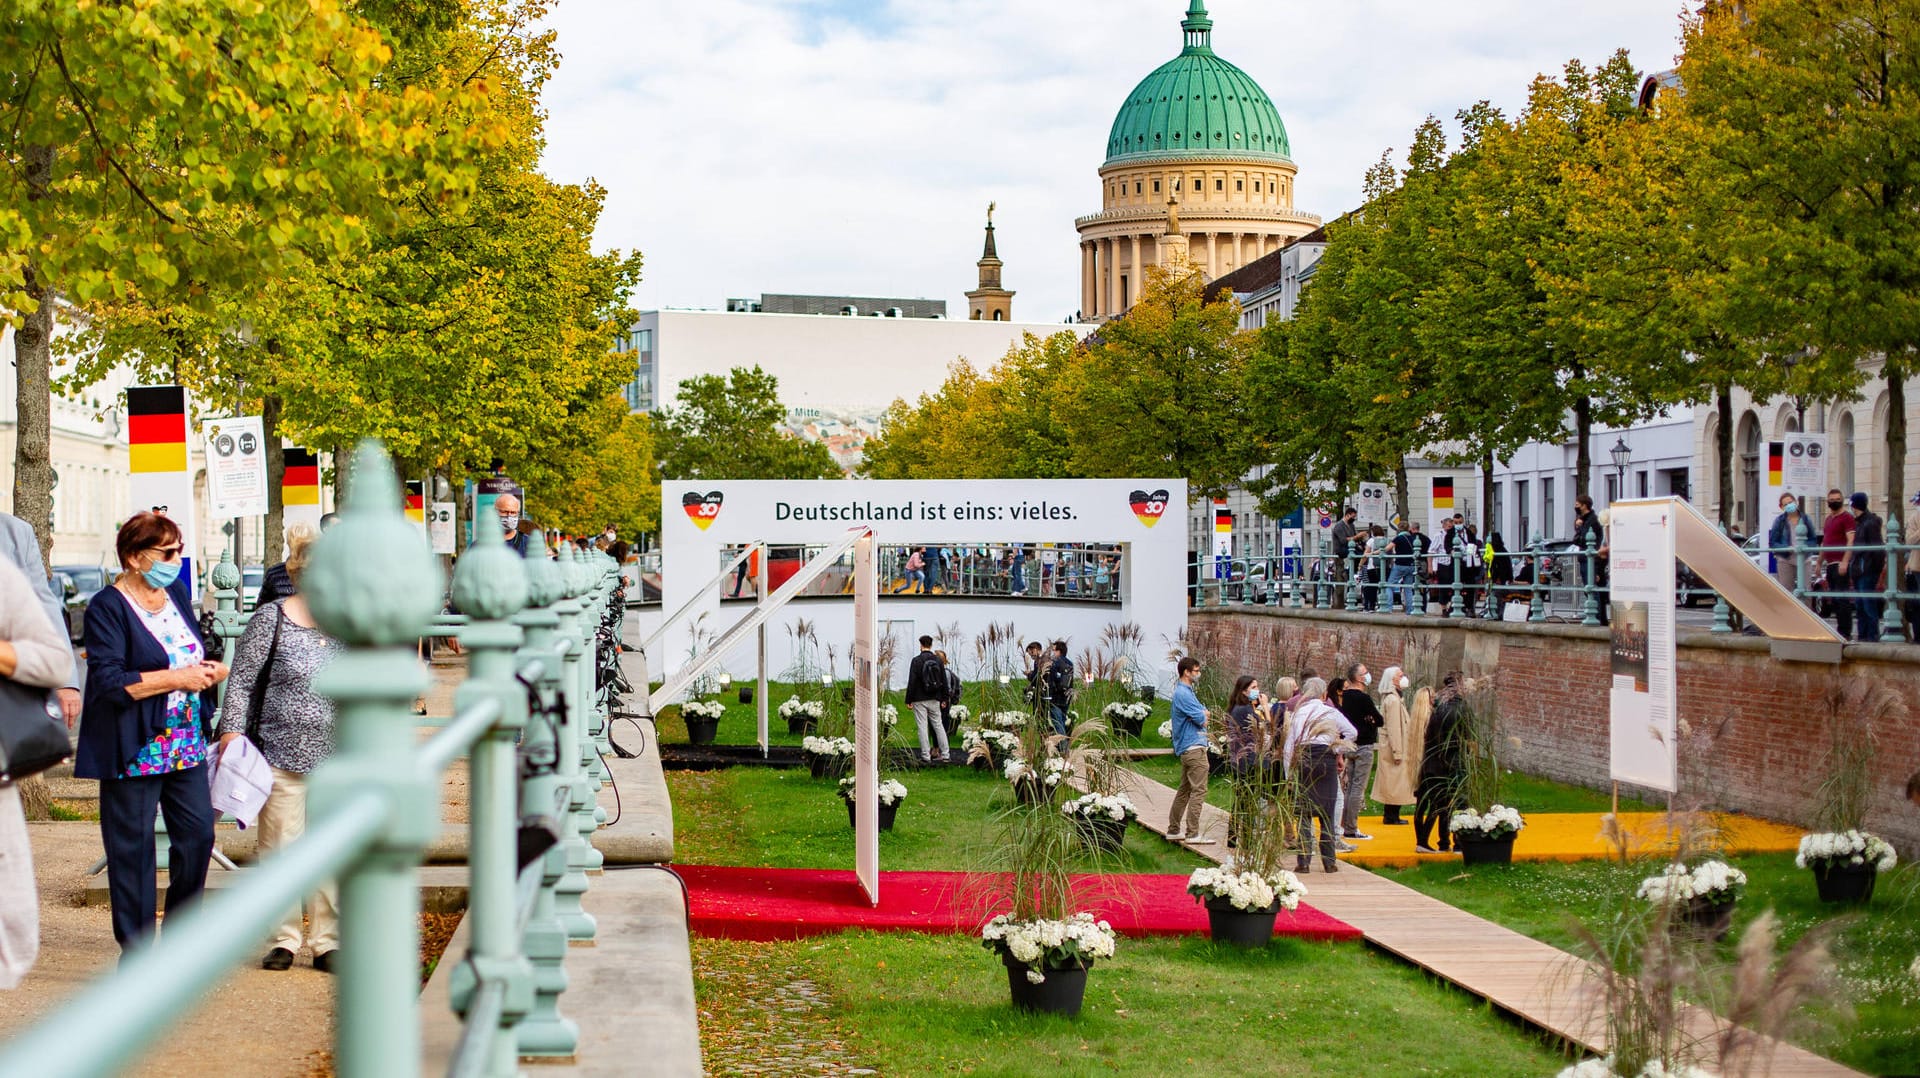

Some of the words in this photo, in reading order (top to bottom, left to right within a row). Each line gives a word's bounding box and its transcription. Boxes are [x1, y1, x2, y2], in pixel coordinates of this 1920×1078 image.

[794, 408, 821, 417] Mitte
[698, 502, 718, 516] 30
[776, 501, 913, 521] Deutschland
[921, 501, 946, 521] ist
[953, 501, 1003, 521] eins:
[1009, 501, 1078, 521] vieles.
[1144, 501, 1163, 514] 30
